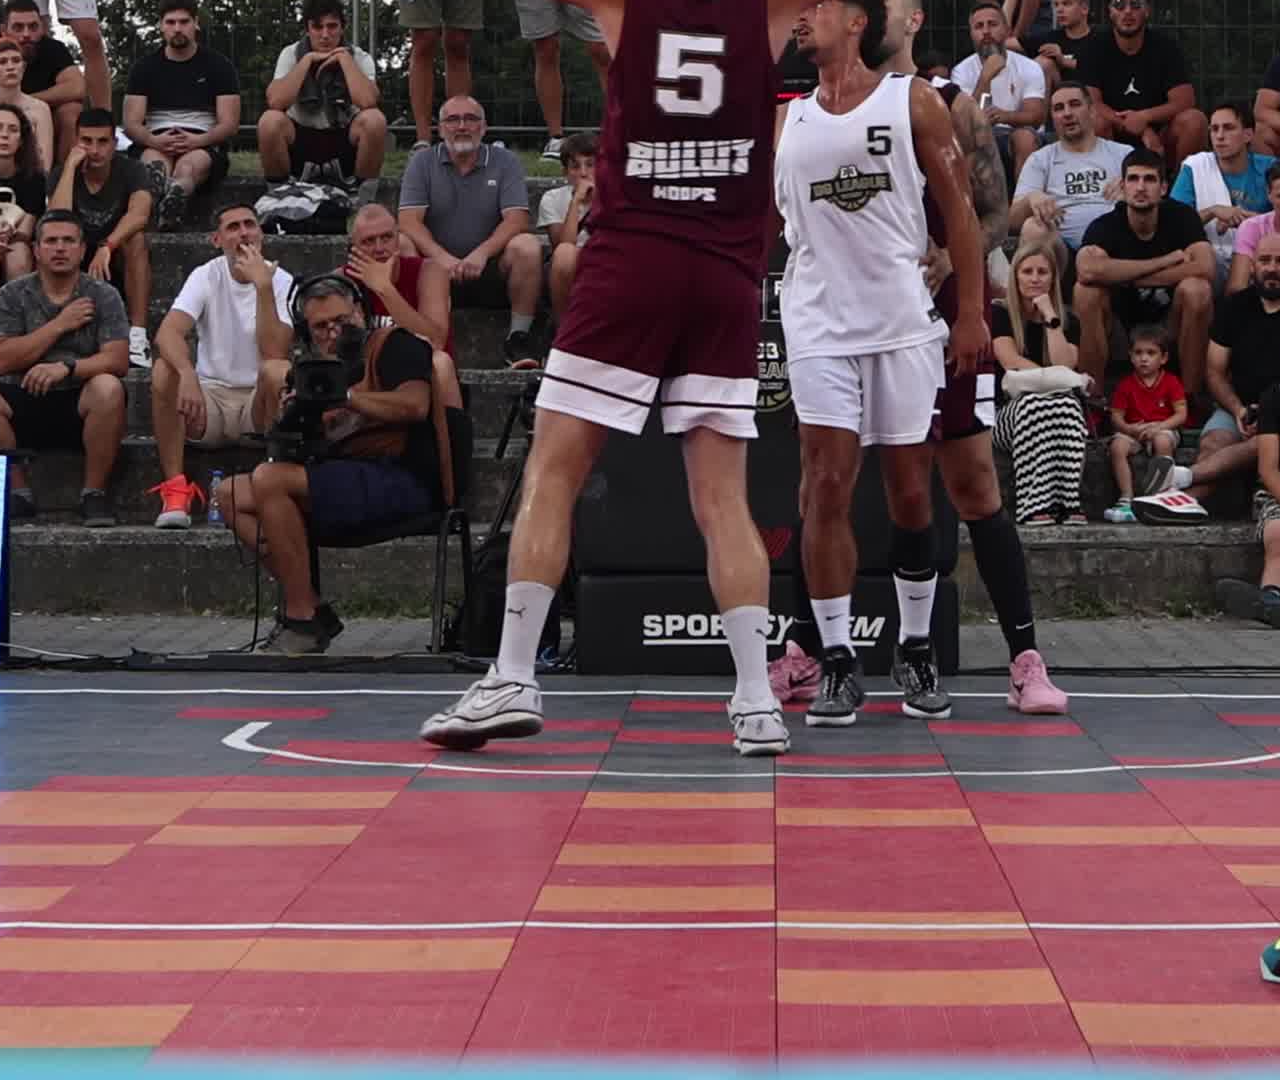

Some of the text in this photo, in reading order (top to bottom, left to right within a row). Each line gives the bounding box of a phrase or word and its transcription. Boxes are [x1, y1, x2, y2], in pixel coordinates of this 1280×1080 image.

[654, 31, 726, 117] 5
[866, 126, 892, 155] 5
[625, 138, 755, 179] BULUT
[1064, 169, 1107, 185] DANU
[652, 184, 717, 202] HOOPS
